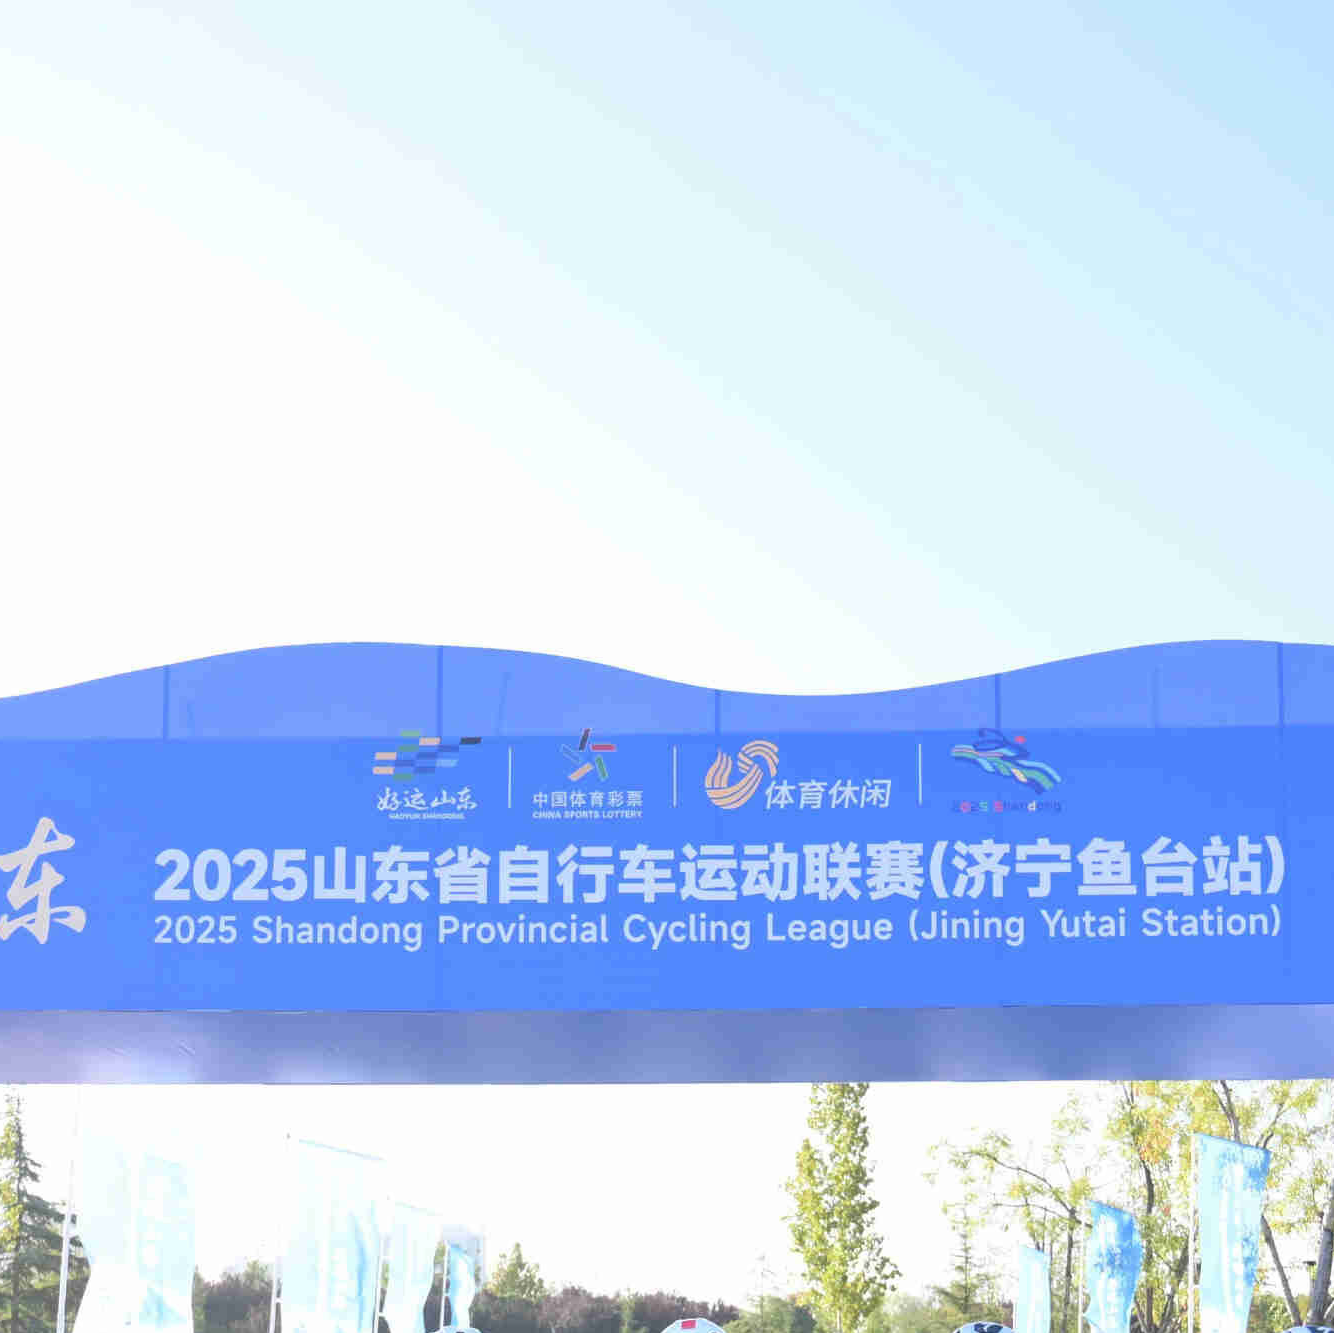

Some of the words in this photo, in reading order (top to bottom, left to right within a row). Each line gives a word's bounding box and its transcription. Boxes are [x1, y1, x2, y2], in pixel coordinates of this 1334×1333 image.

[377, 787, 478, 811] 好运山东
[533, 791, 643, 808] 中国体育彩票
[765, 779, 891, 809] 体育休闲
[532, 811, 561, 820] CHINA
[564, 810, 600, 820] SPORTS
[603, 810, 642, 820] LOTTERY
[154, 835, 1285, 905] 2025山东省自行车运动联赛(济宁鱼台站)
[154, 914, 237, 944] 2025
[252, 914, 423, 952] Shandong
[439, 914, 609, 945] Provincial
[623, 913, 751, 951] Cycling
[767, 912, 893, 949] League
[909, 909, 1025, 946] (Jining
[1041, 907, 1126, 938] Yutai
[1142, 906, 1281, 938] Station)
